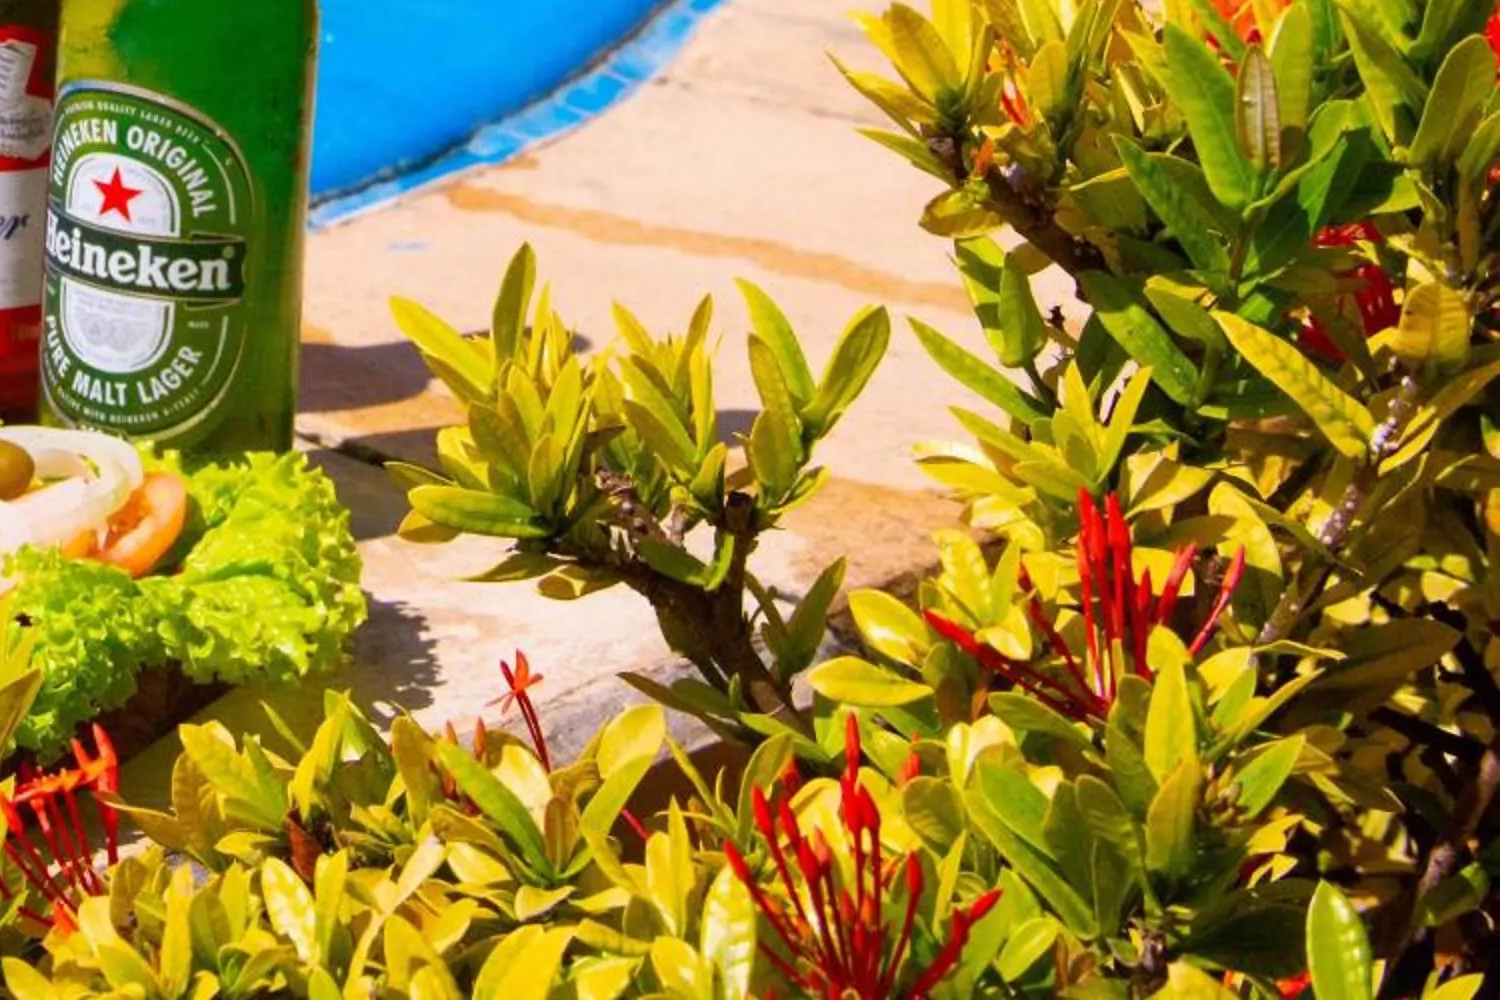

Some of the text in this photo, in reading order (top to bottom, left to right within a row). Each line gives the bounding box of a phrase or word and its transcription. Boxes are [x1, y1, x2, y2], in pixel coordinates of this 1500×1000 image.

[53, 117, 216, 217] HEINEKEN ORIGINAL
[46, 315, 71, 378] PURE
[72, 370, 127, 407] MALT
[137, 346, 203, 405] LAGER
